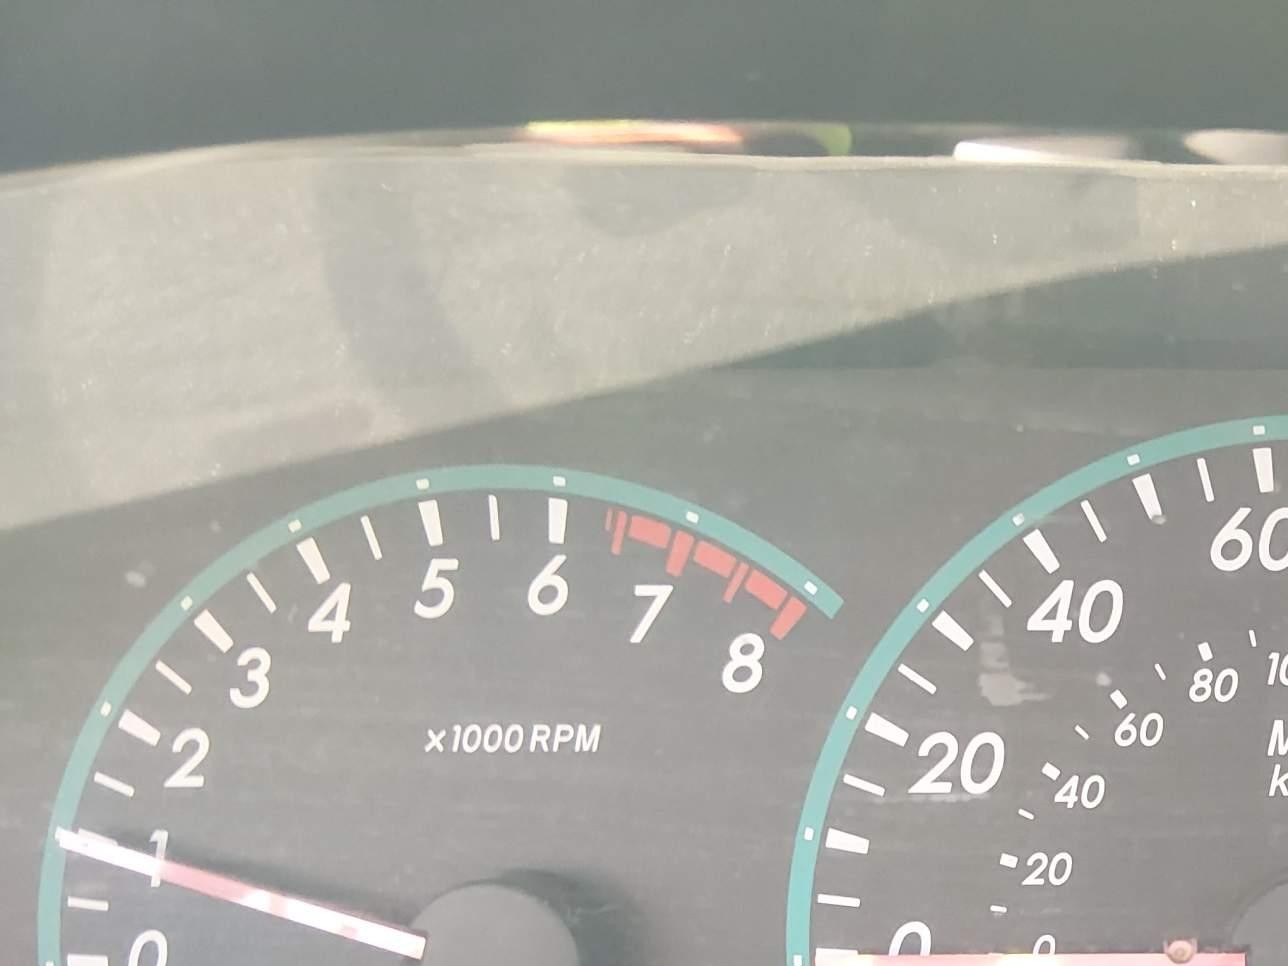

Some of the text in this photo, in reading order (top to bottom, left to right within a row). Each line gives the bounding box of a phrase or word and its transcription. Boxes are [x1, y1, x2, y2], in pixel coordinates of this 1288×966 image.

[308, 583, 352, 643] 4
[414, 558, 459, 619] 5
[527, 555, 568, 616] 6
[629, 584, 674, 644] 7
[1026, 579, 1124, 643] 40
[229, 647, 271, 709] 3
[721, 633, 765, 693] 8
[1188, 668, 1239, 702] 80
[163, 728, 211, 789] 2
[529, 725, 602, 754] RPM
[1113, 713, 1164, 747] 60
[907, 731, 1006, 795] 20
[1053, 775, 1105, 809] 40
[1021, 852, 1073, 886] 20
